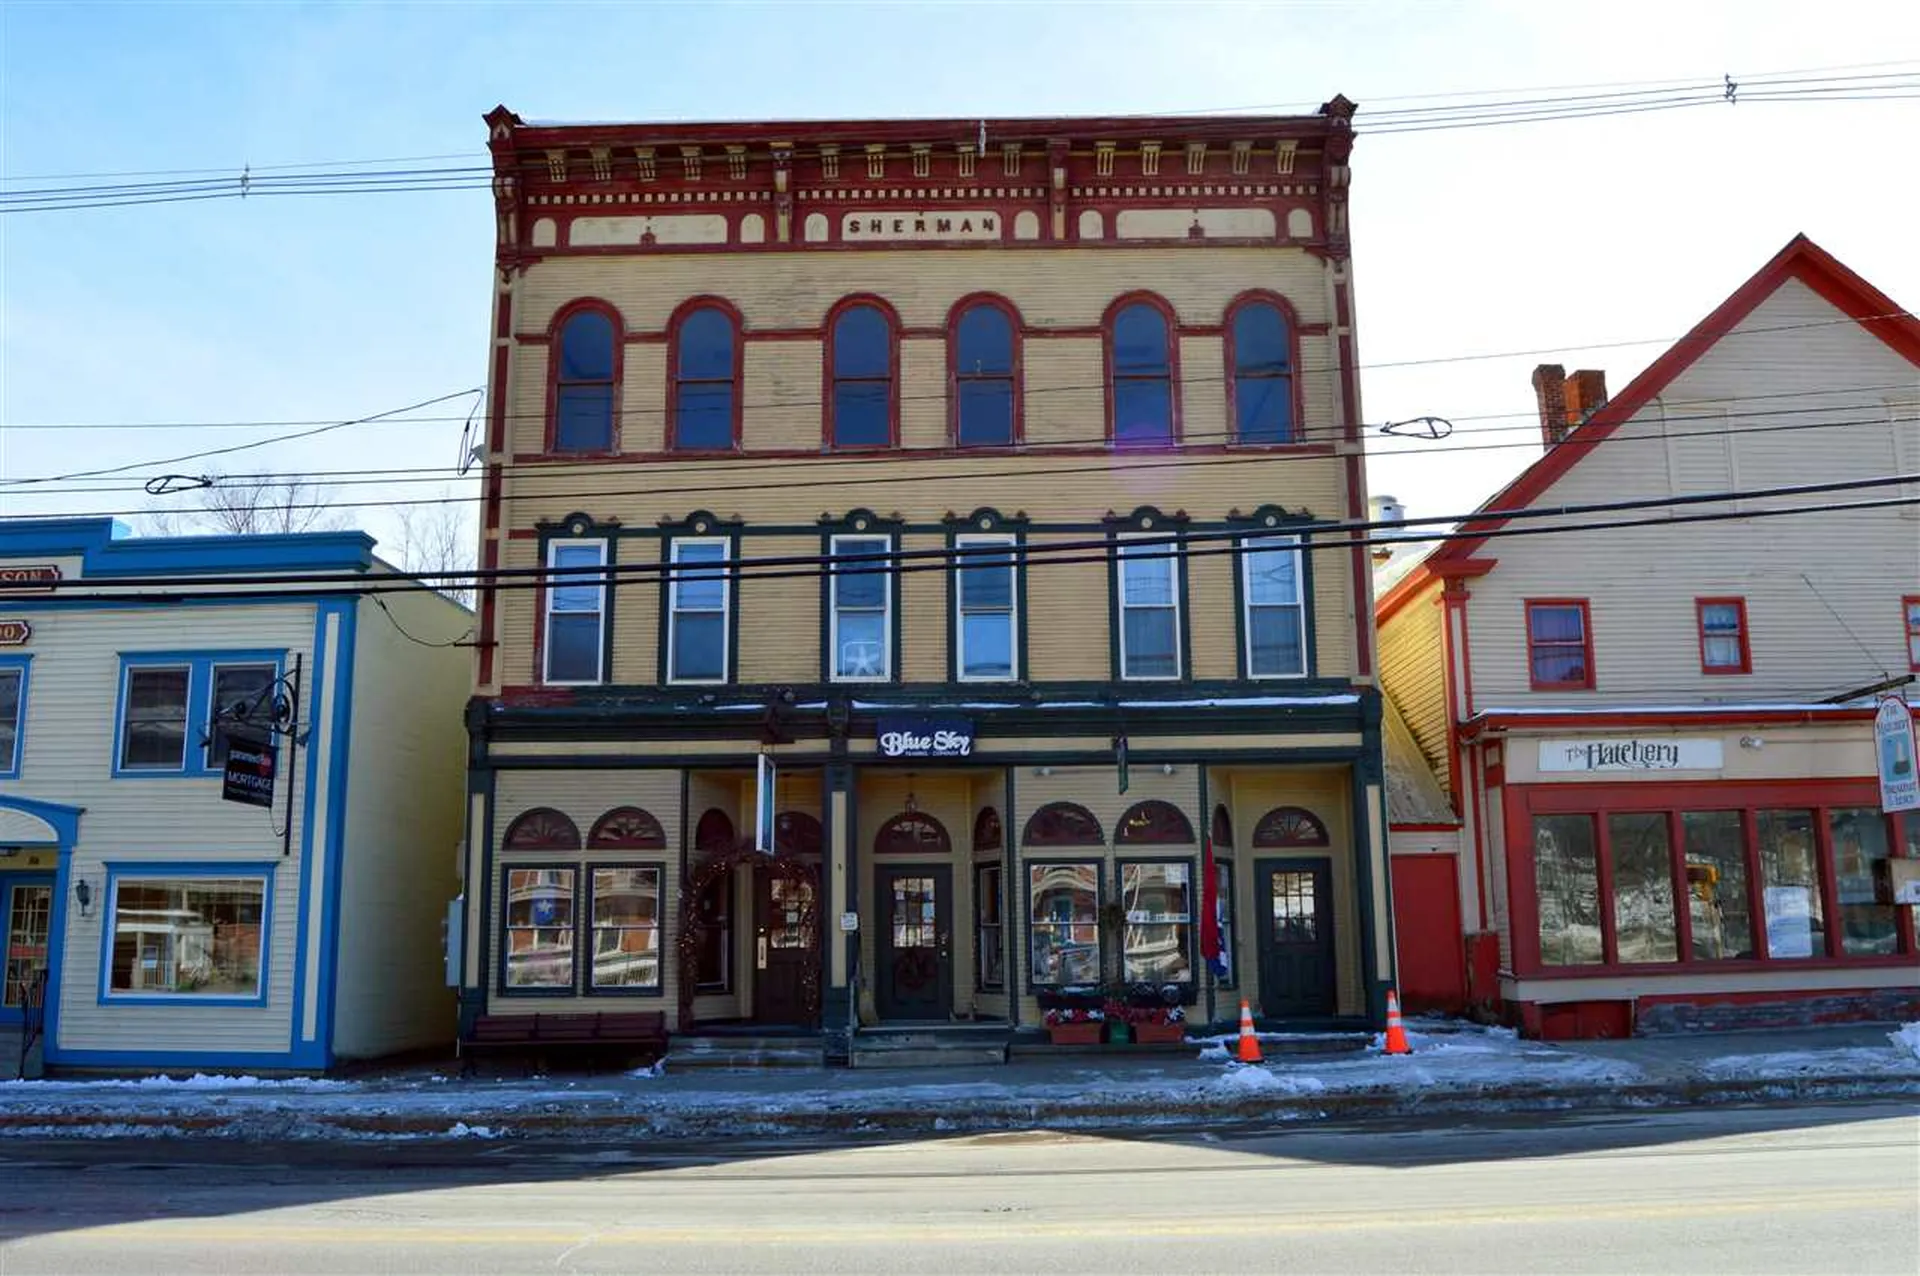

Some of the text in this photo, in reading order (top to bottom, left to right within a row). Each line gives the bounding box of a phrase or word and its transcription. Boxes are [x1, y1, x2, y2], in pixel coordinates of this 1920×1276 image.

[849, 218, 995, 233] SHERMAN
[880, 731, 970, 756] Blue Sky
[1586, 740, 1679, 769] Hatchery
[228, 771, 272, 790] MORTGAGE
